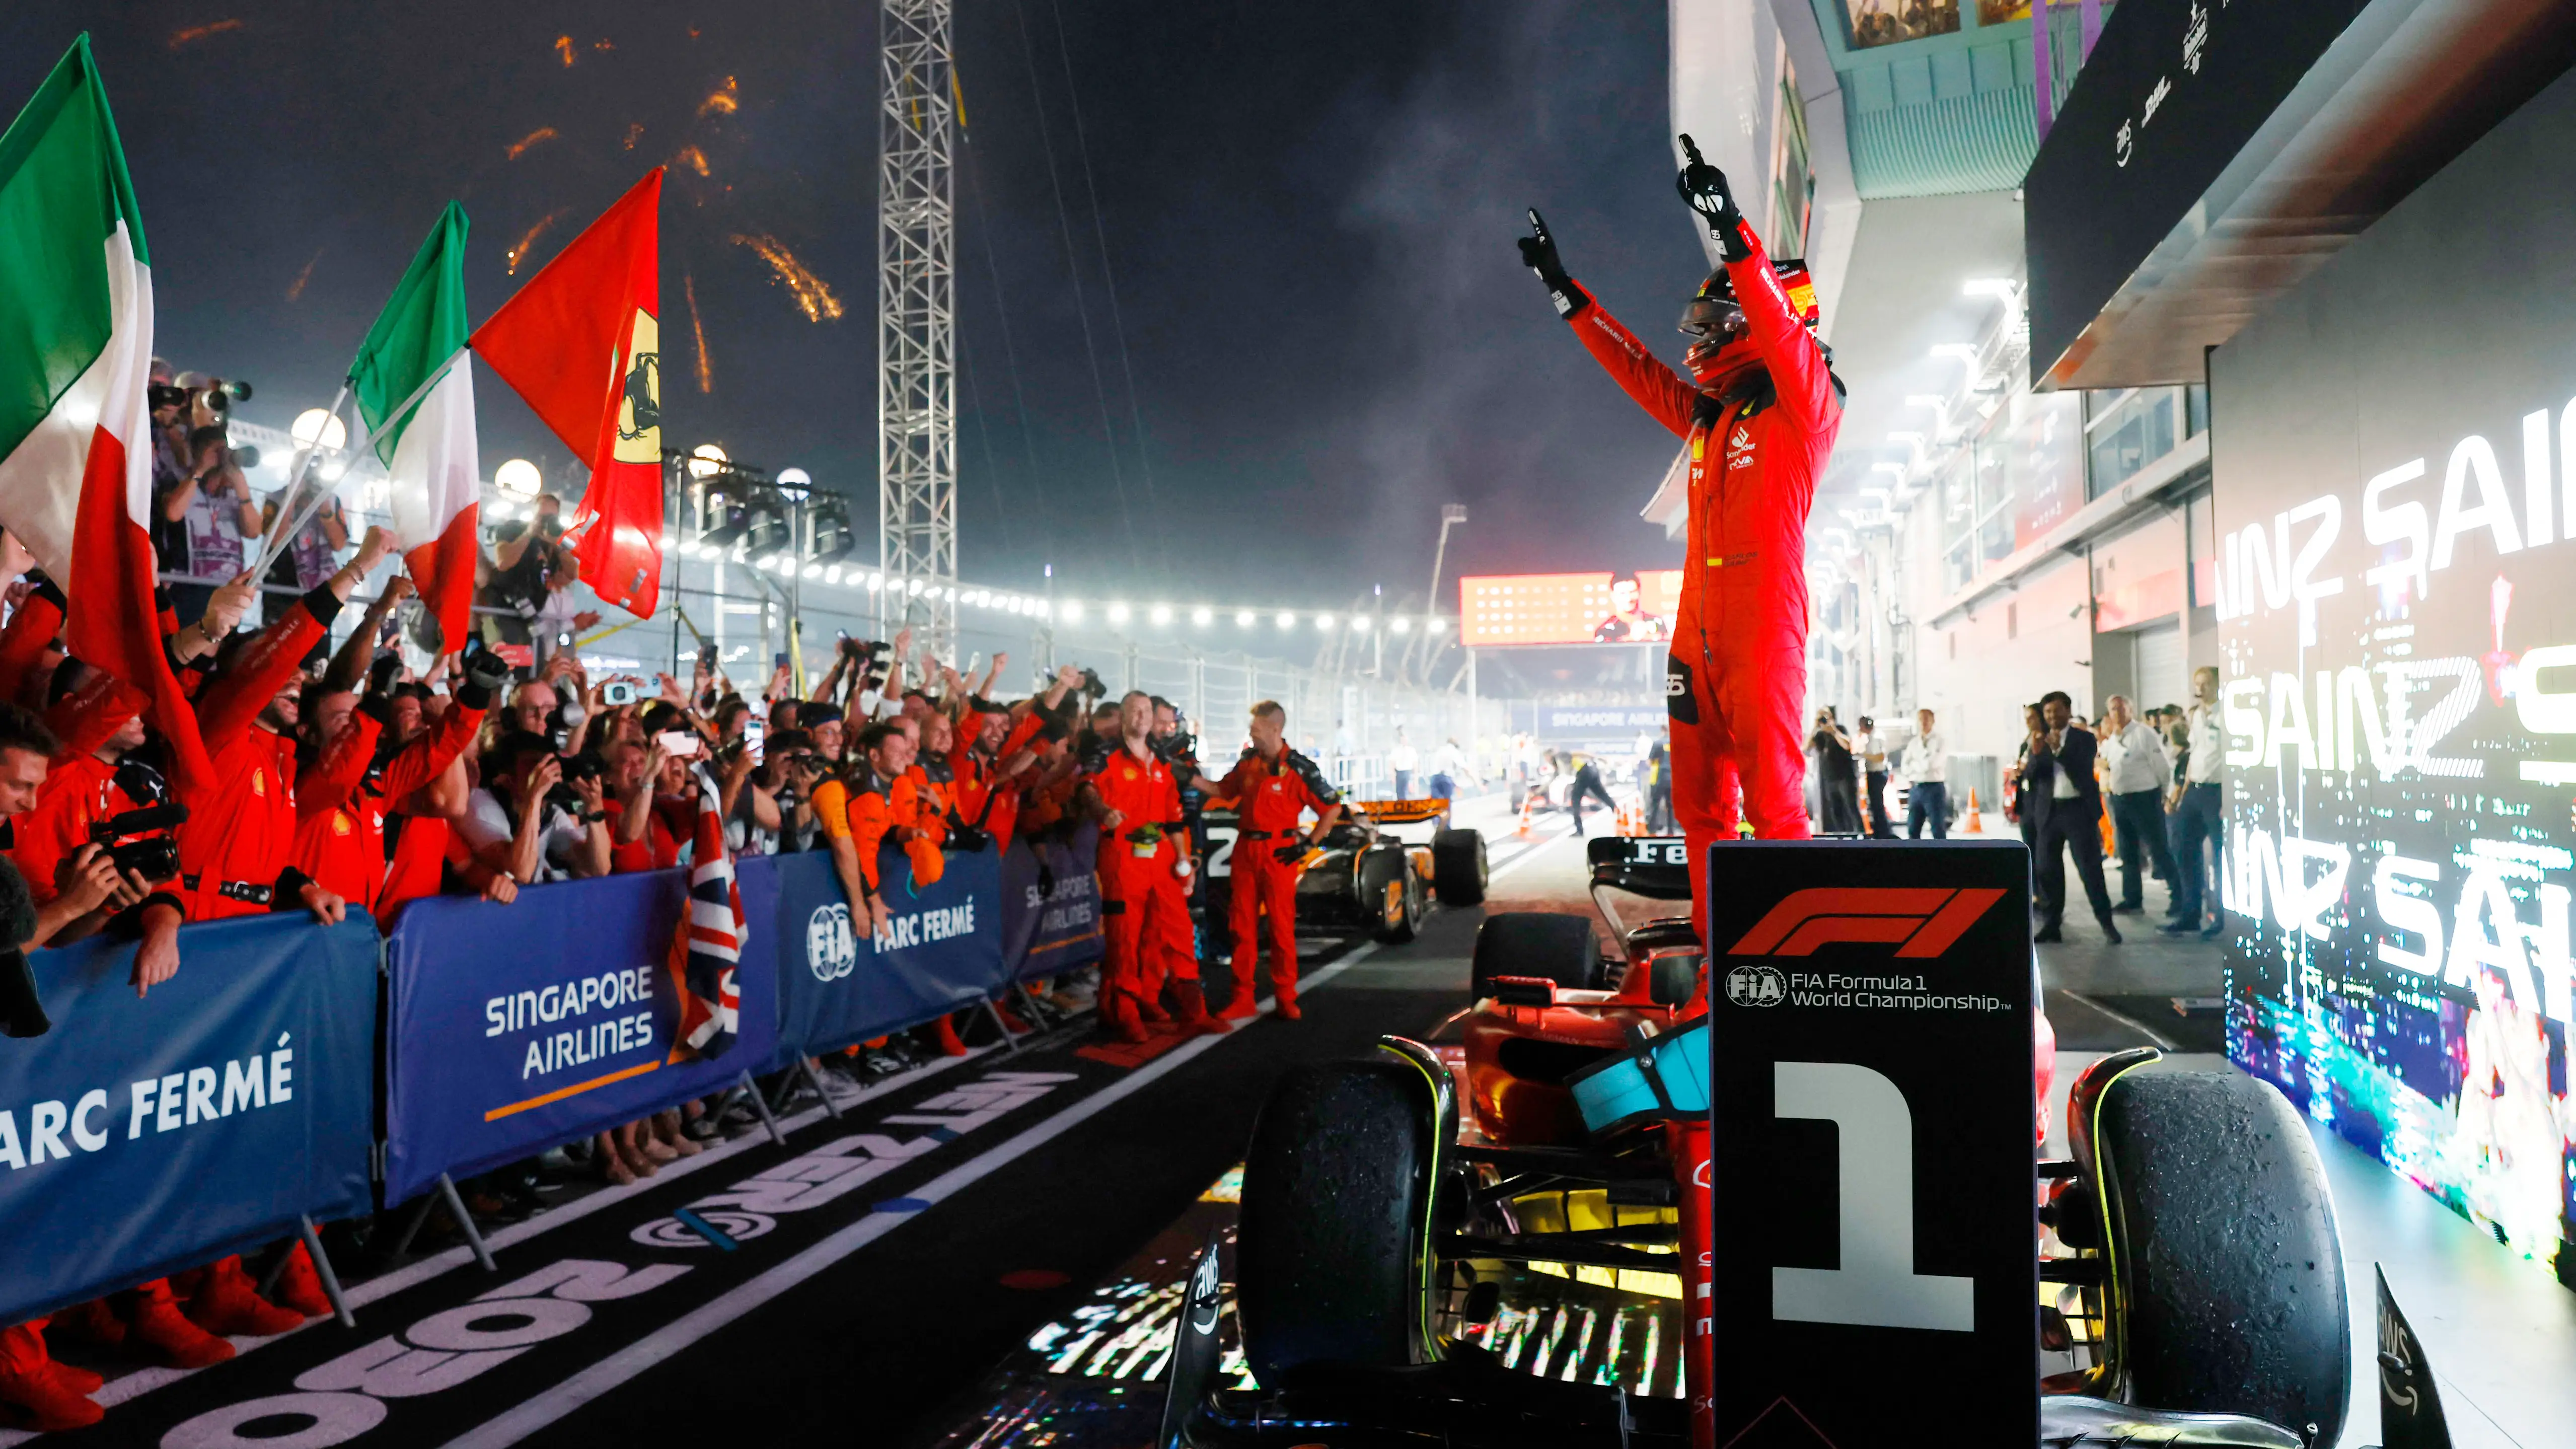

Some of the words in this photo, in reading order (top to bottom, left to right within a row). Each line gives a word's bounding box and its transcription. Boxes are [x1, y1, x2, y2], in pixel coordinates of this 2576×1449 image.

[1759, 267, 1784, 303] RICHARD
[2222, 655, 2485, 779] SAINZ
[922, 895, 975, 943] FERMÉ
[1727, 888, 2008, 958] F1
[485, 965, 654, 1038] SINGAPORE
[1791, 973, 1824, 988] FIA
[1828, 973, 1911, 990] Formula
[1917, 975, 1927, 990] 1
[1791, 991, 1851, 1007] World
[523, 1012, 653, 1080] AIRLINES
[128, 1031, 293, 1141] FERMÉ
[1772, 1061, 1975, 1332] 1
